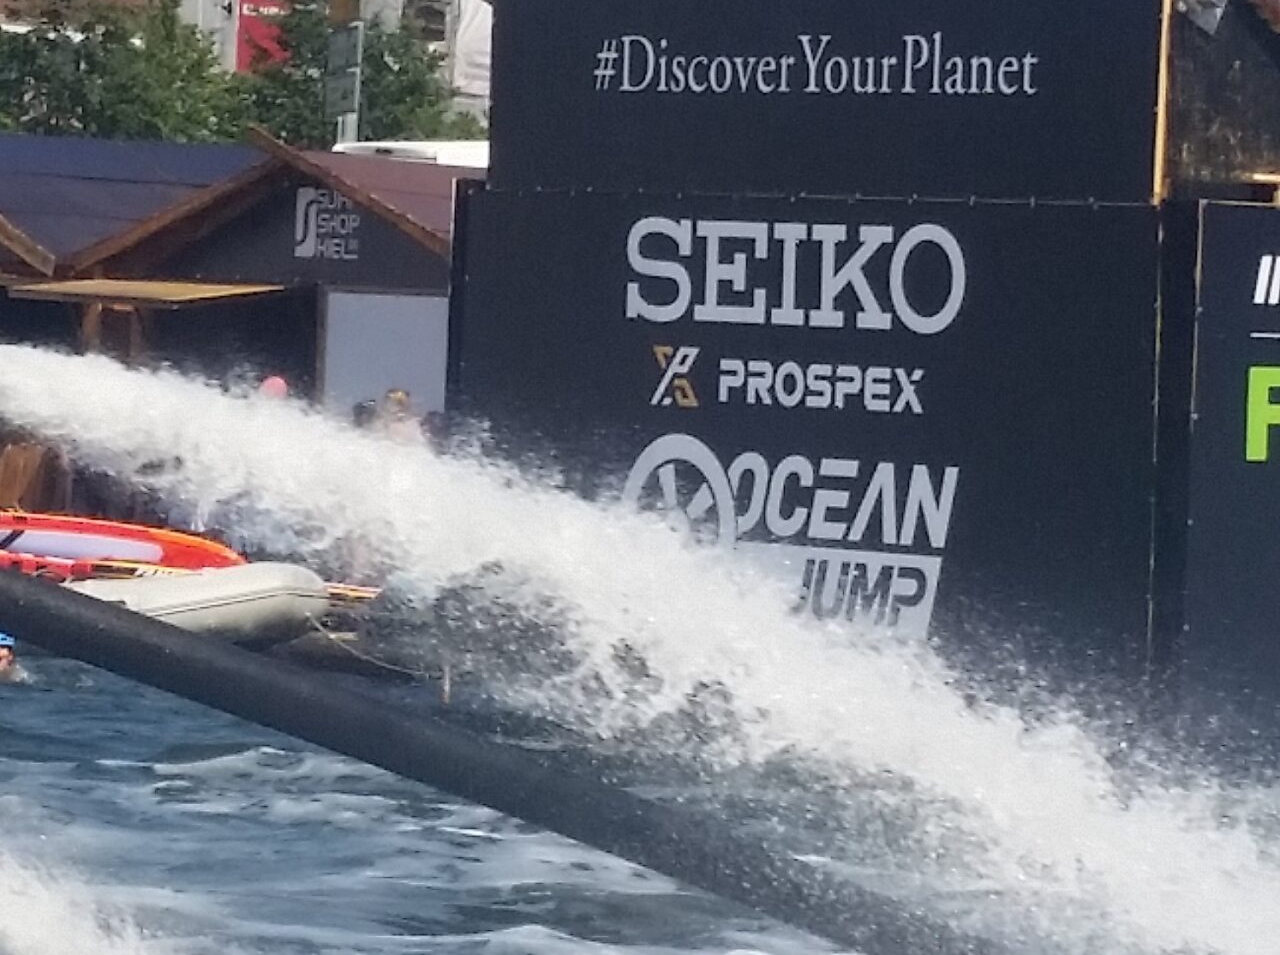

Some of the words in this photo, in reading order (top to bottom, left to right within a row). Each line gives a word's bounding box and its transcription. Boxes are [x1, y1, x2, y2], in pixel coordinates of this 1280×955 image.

[317, 213, 360, 235] SHOP
[625, 216, 966, 335] SEIKO
[718, 357, 925, 414] PROSPEX
[726, 451, 960, 549] OCEAN
